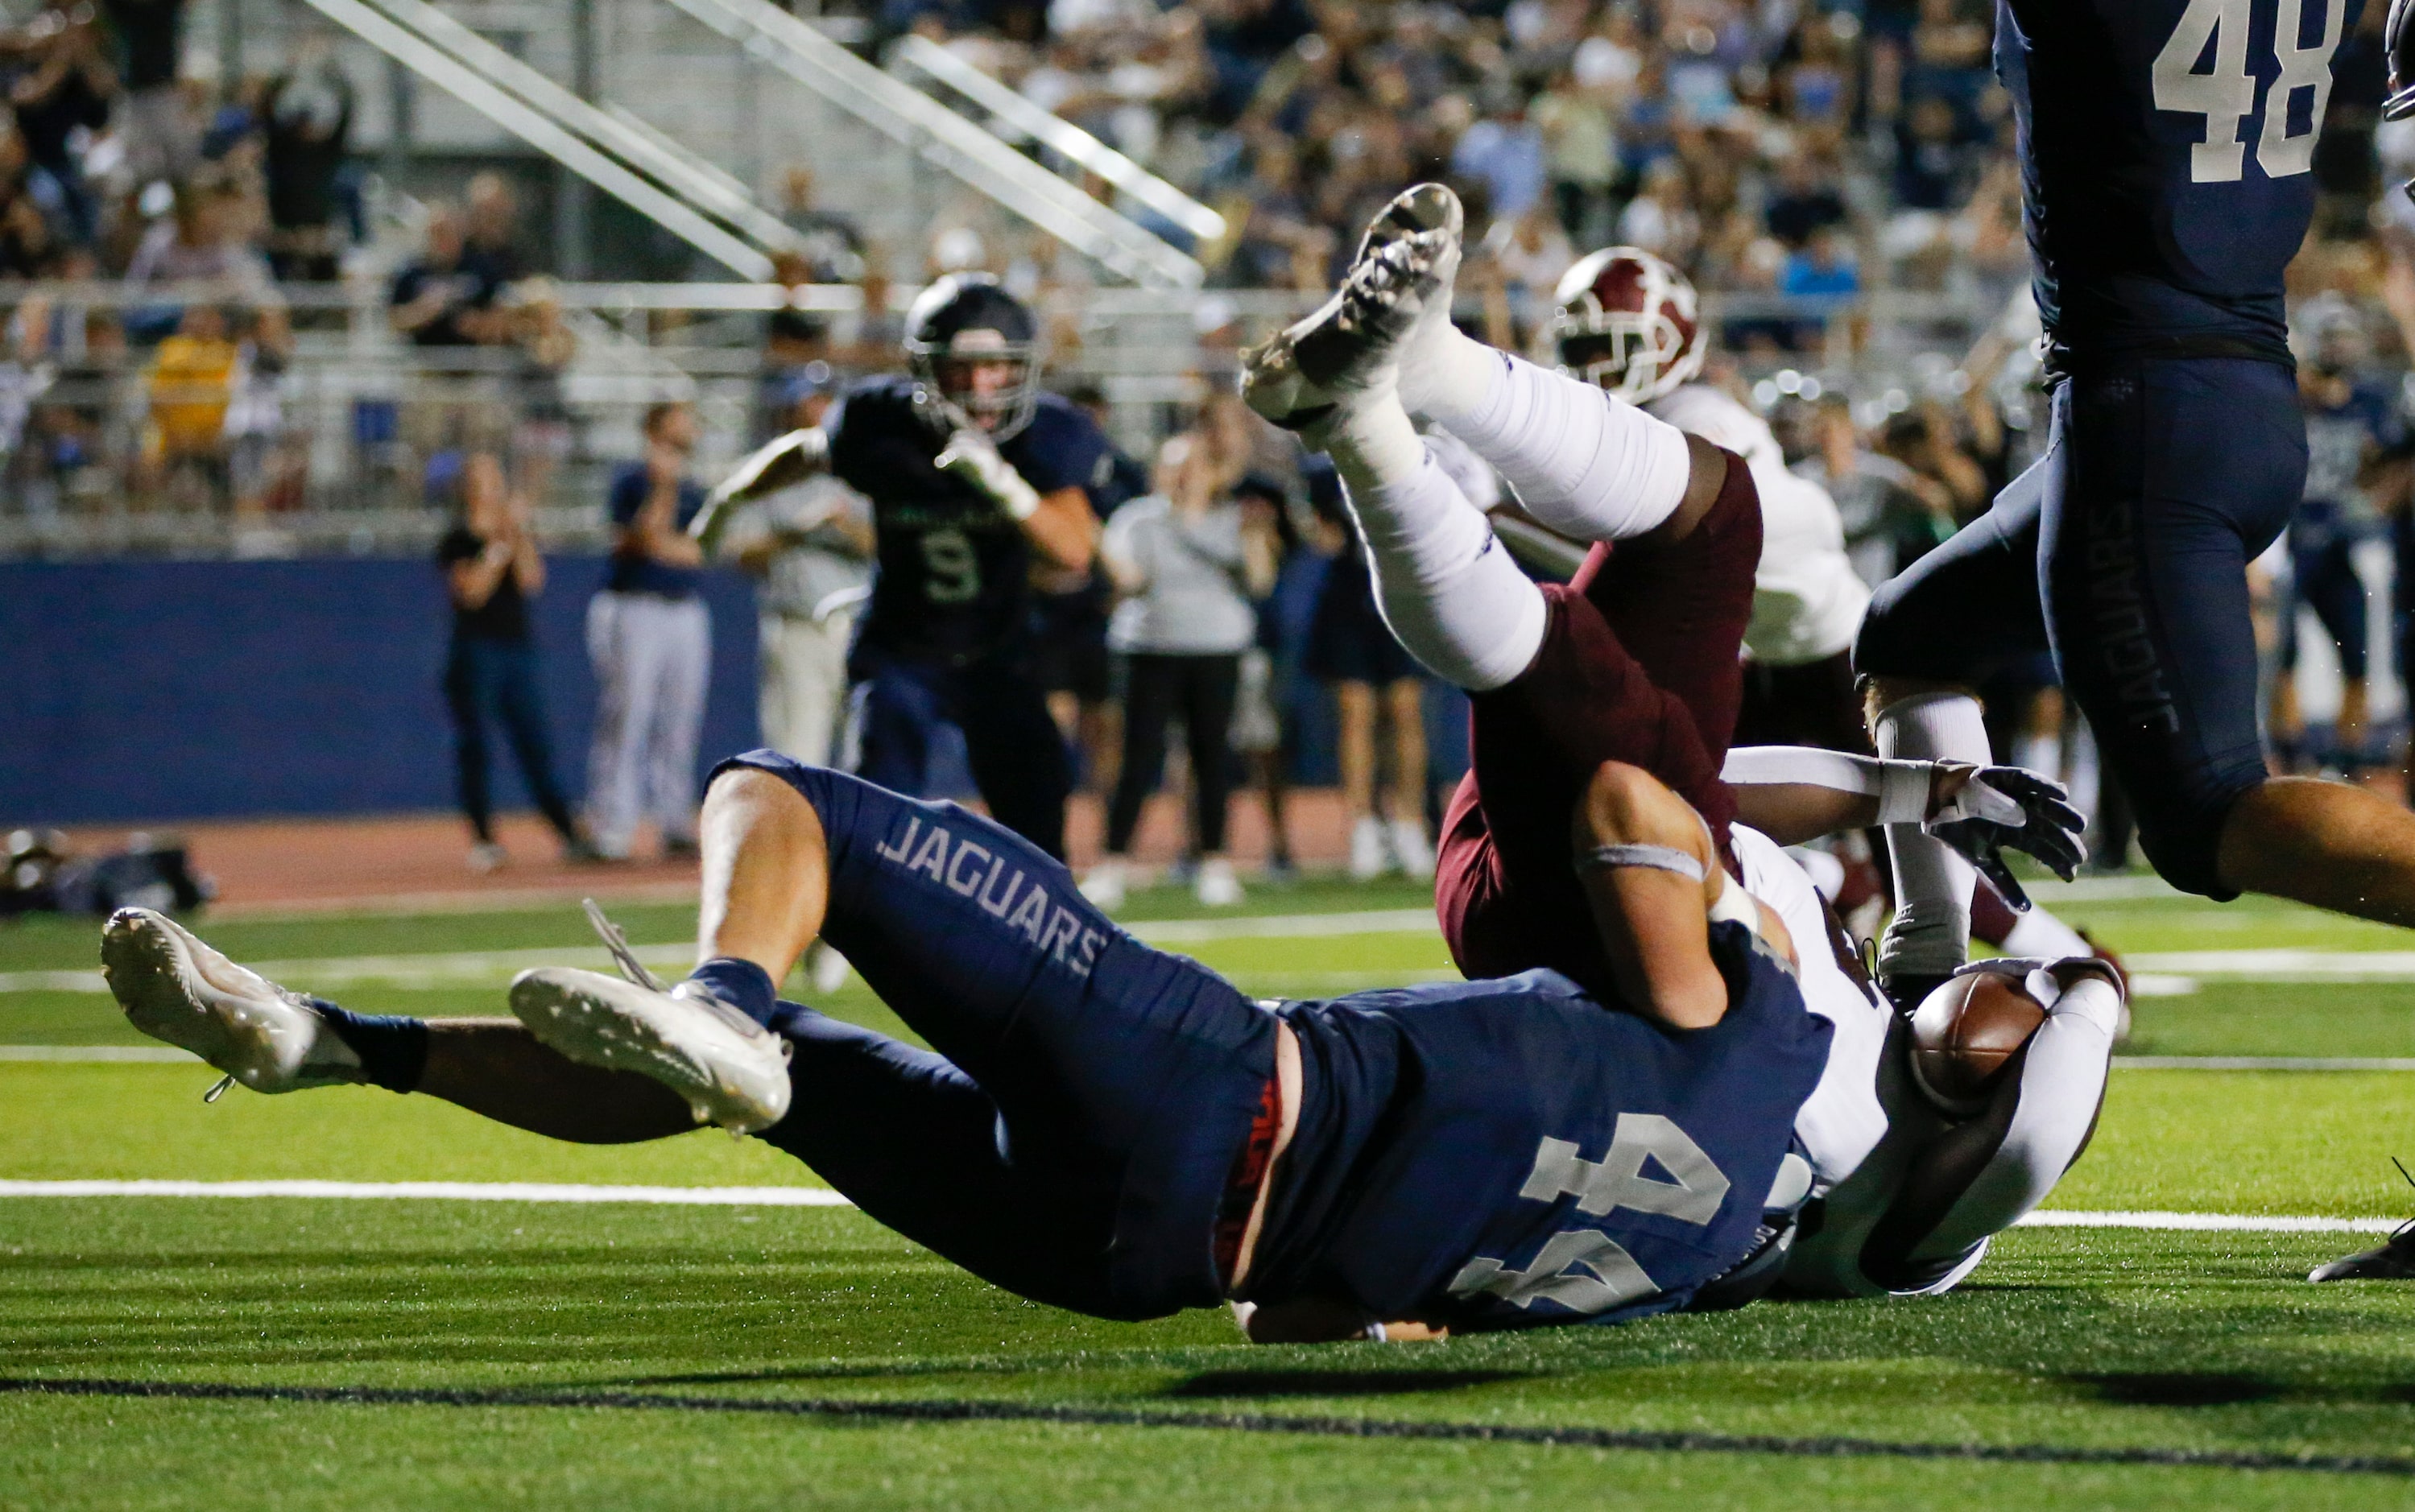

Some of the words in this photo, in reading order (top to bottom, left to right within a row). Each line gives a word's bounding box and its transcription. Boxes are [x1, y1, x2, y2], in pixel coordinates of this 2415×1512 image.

[2152, 0, 2345, 183] 48
[919, 528, 982, 604] 9
[2086, 502, 2181, 733] JAGUARS
[875, 816, 1107, 977] JAGUARS
[1447, 1112, 1731, 1314] 44
